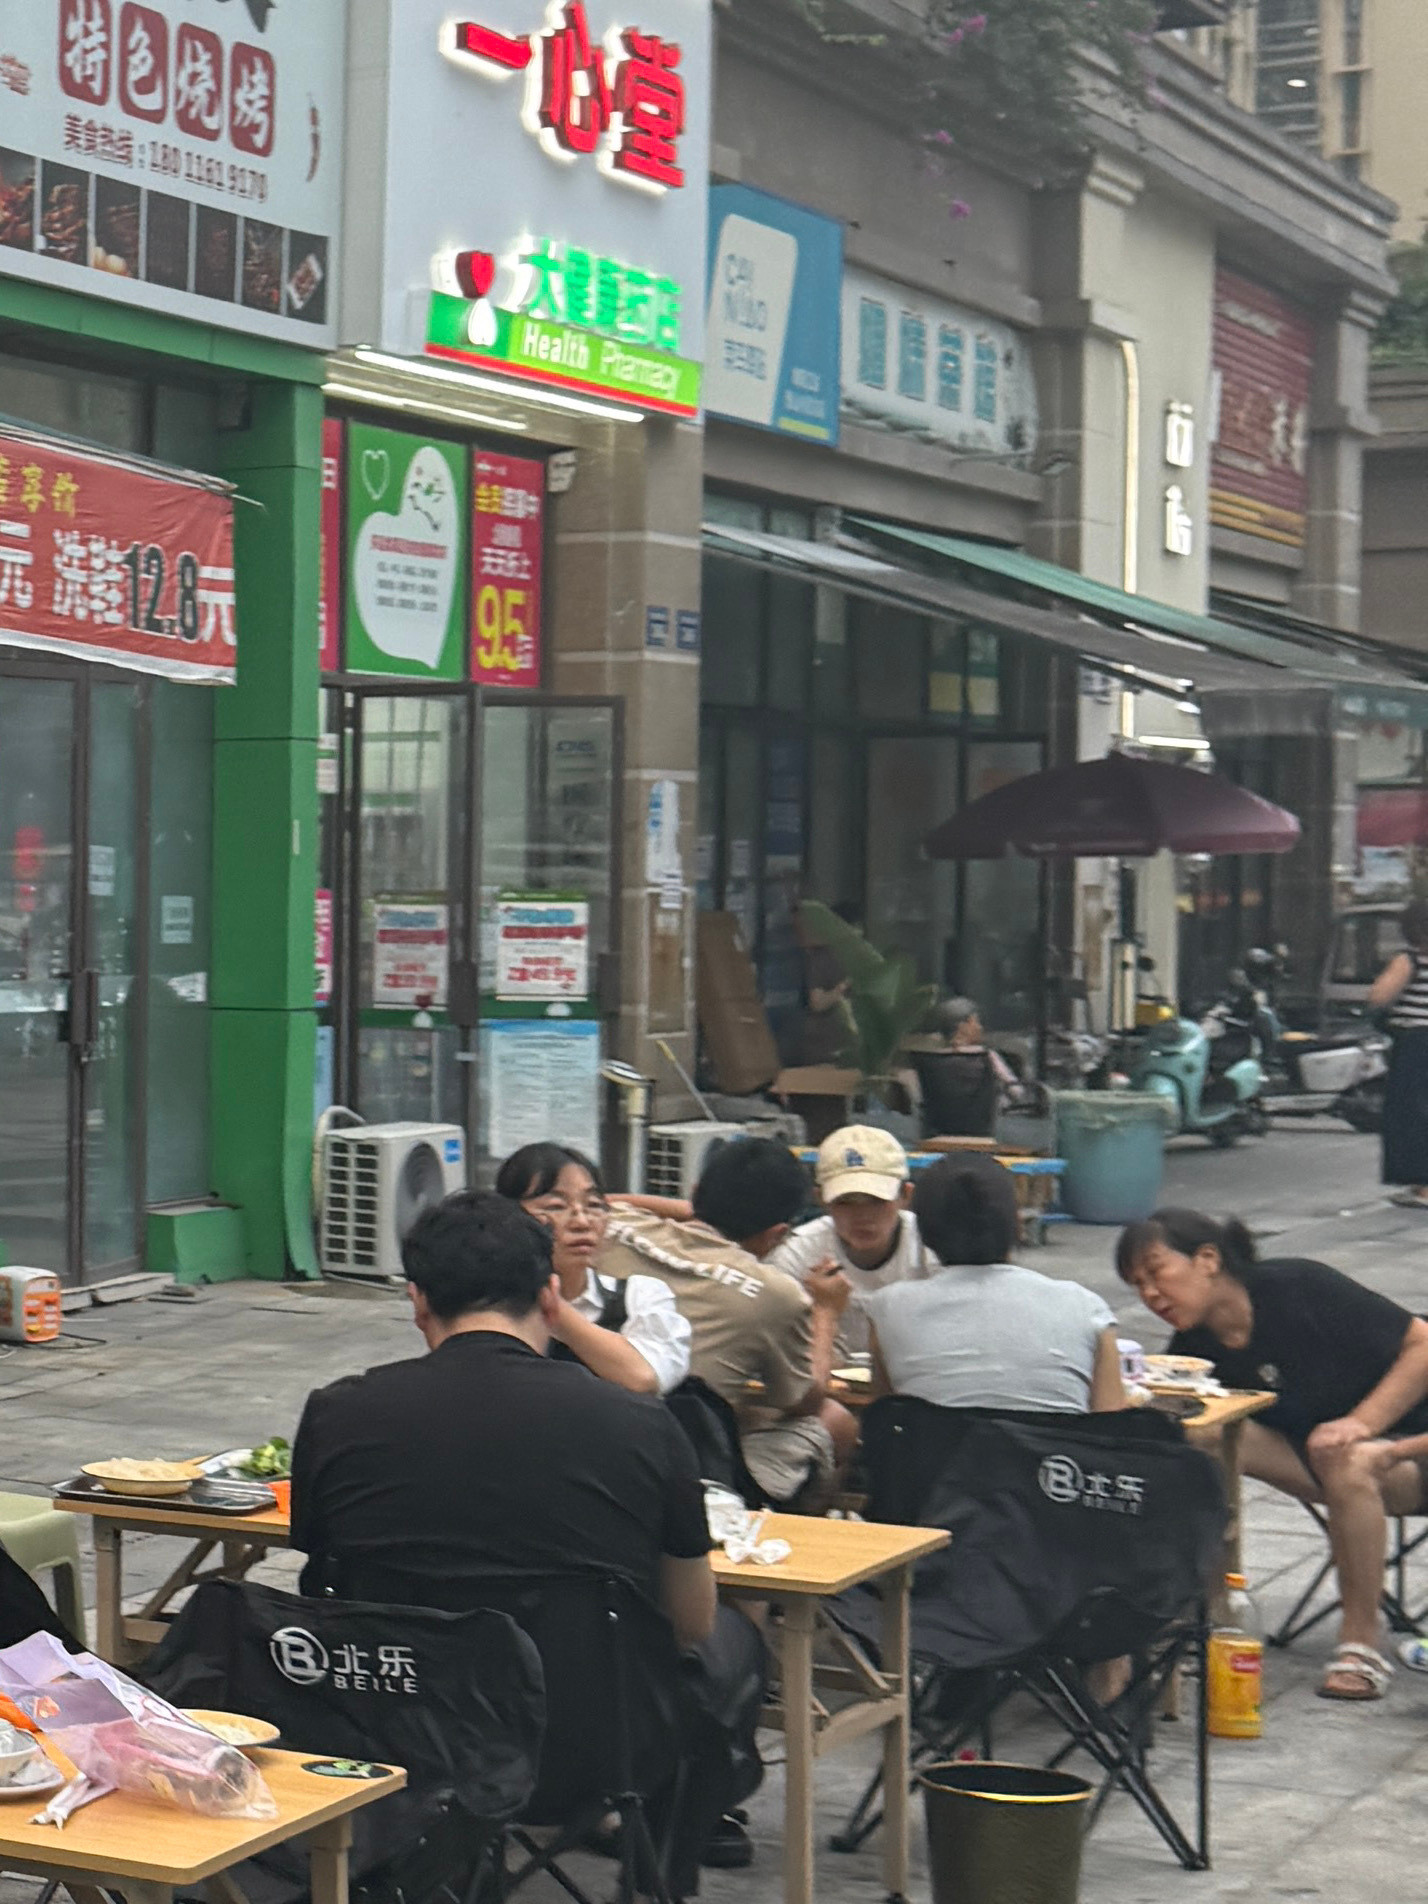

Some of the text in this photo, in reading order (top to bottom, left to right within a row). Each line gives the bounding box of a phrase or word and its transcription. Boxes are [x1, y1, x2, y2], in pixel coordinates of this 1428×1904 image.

[523, 320, 591, 371] Health
[332, 1643, 418, 1678] 北乐
[333, 1672, 419, 1694] BEILE
